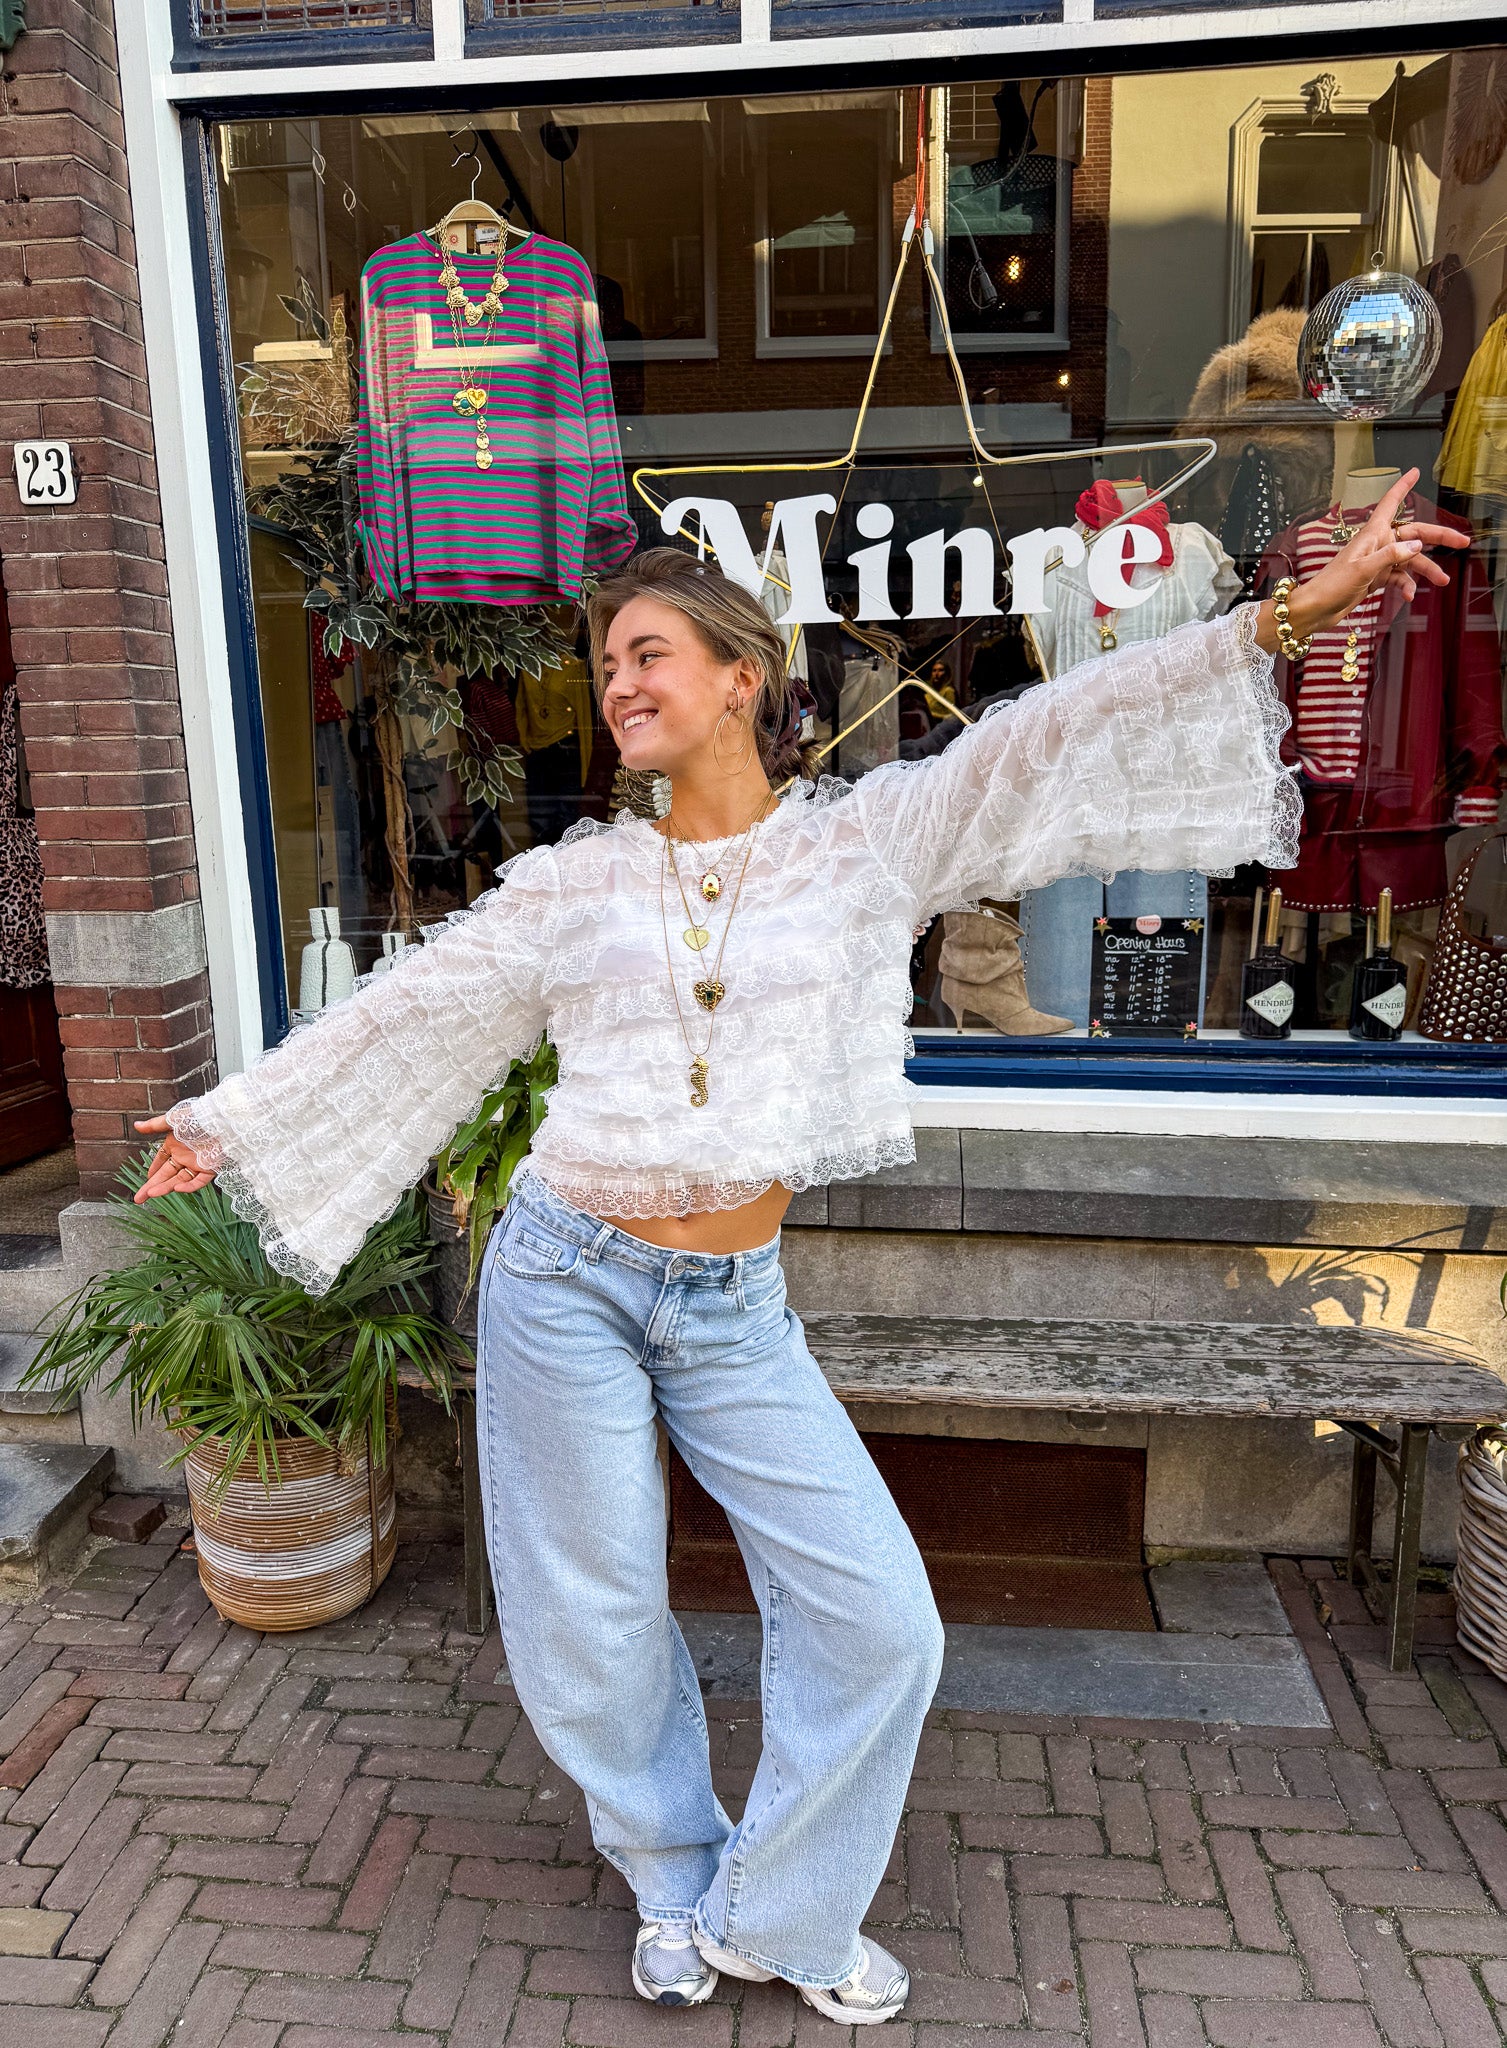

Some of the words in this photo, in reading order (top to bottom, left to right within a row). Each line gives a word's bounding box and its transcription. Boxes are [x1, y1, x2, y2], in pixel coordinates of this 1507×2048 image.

[22, 447, 67, 498] 23
[661, 493, 1164, 625] Minre
[1105, 934, 1151, 952] Opening
[1155, 936, 1186, 948] Hours
